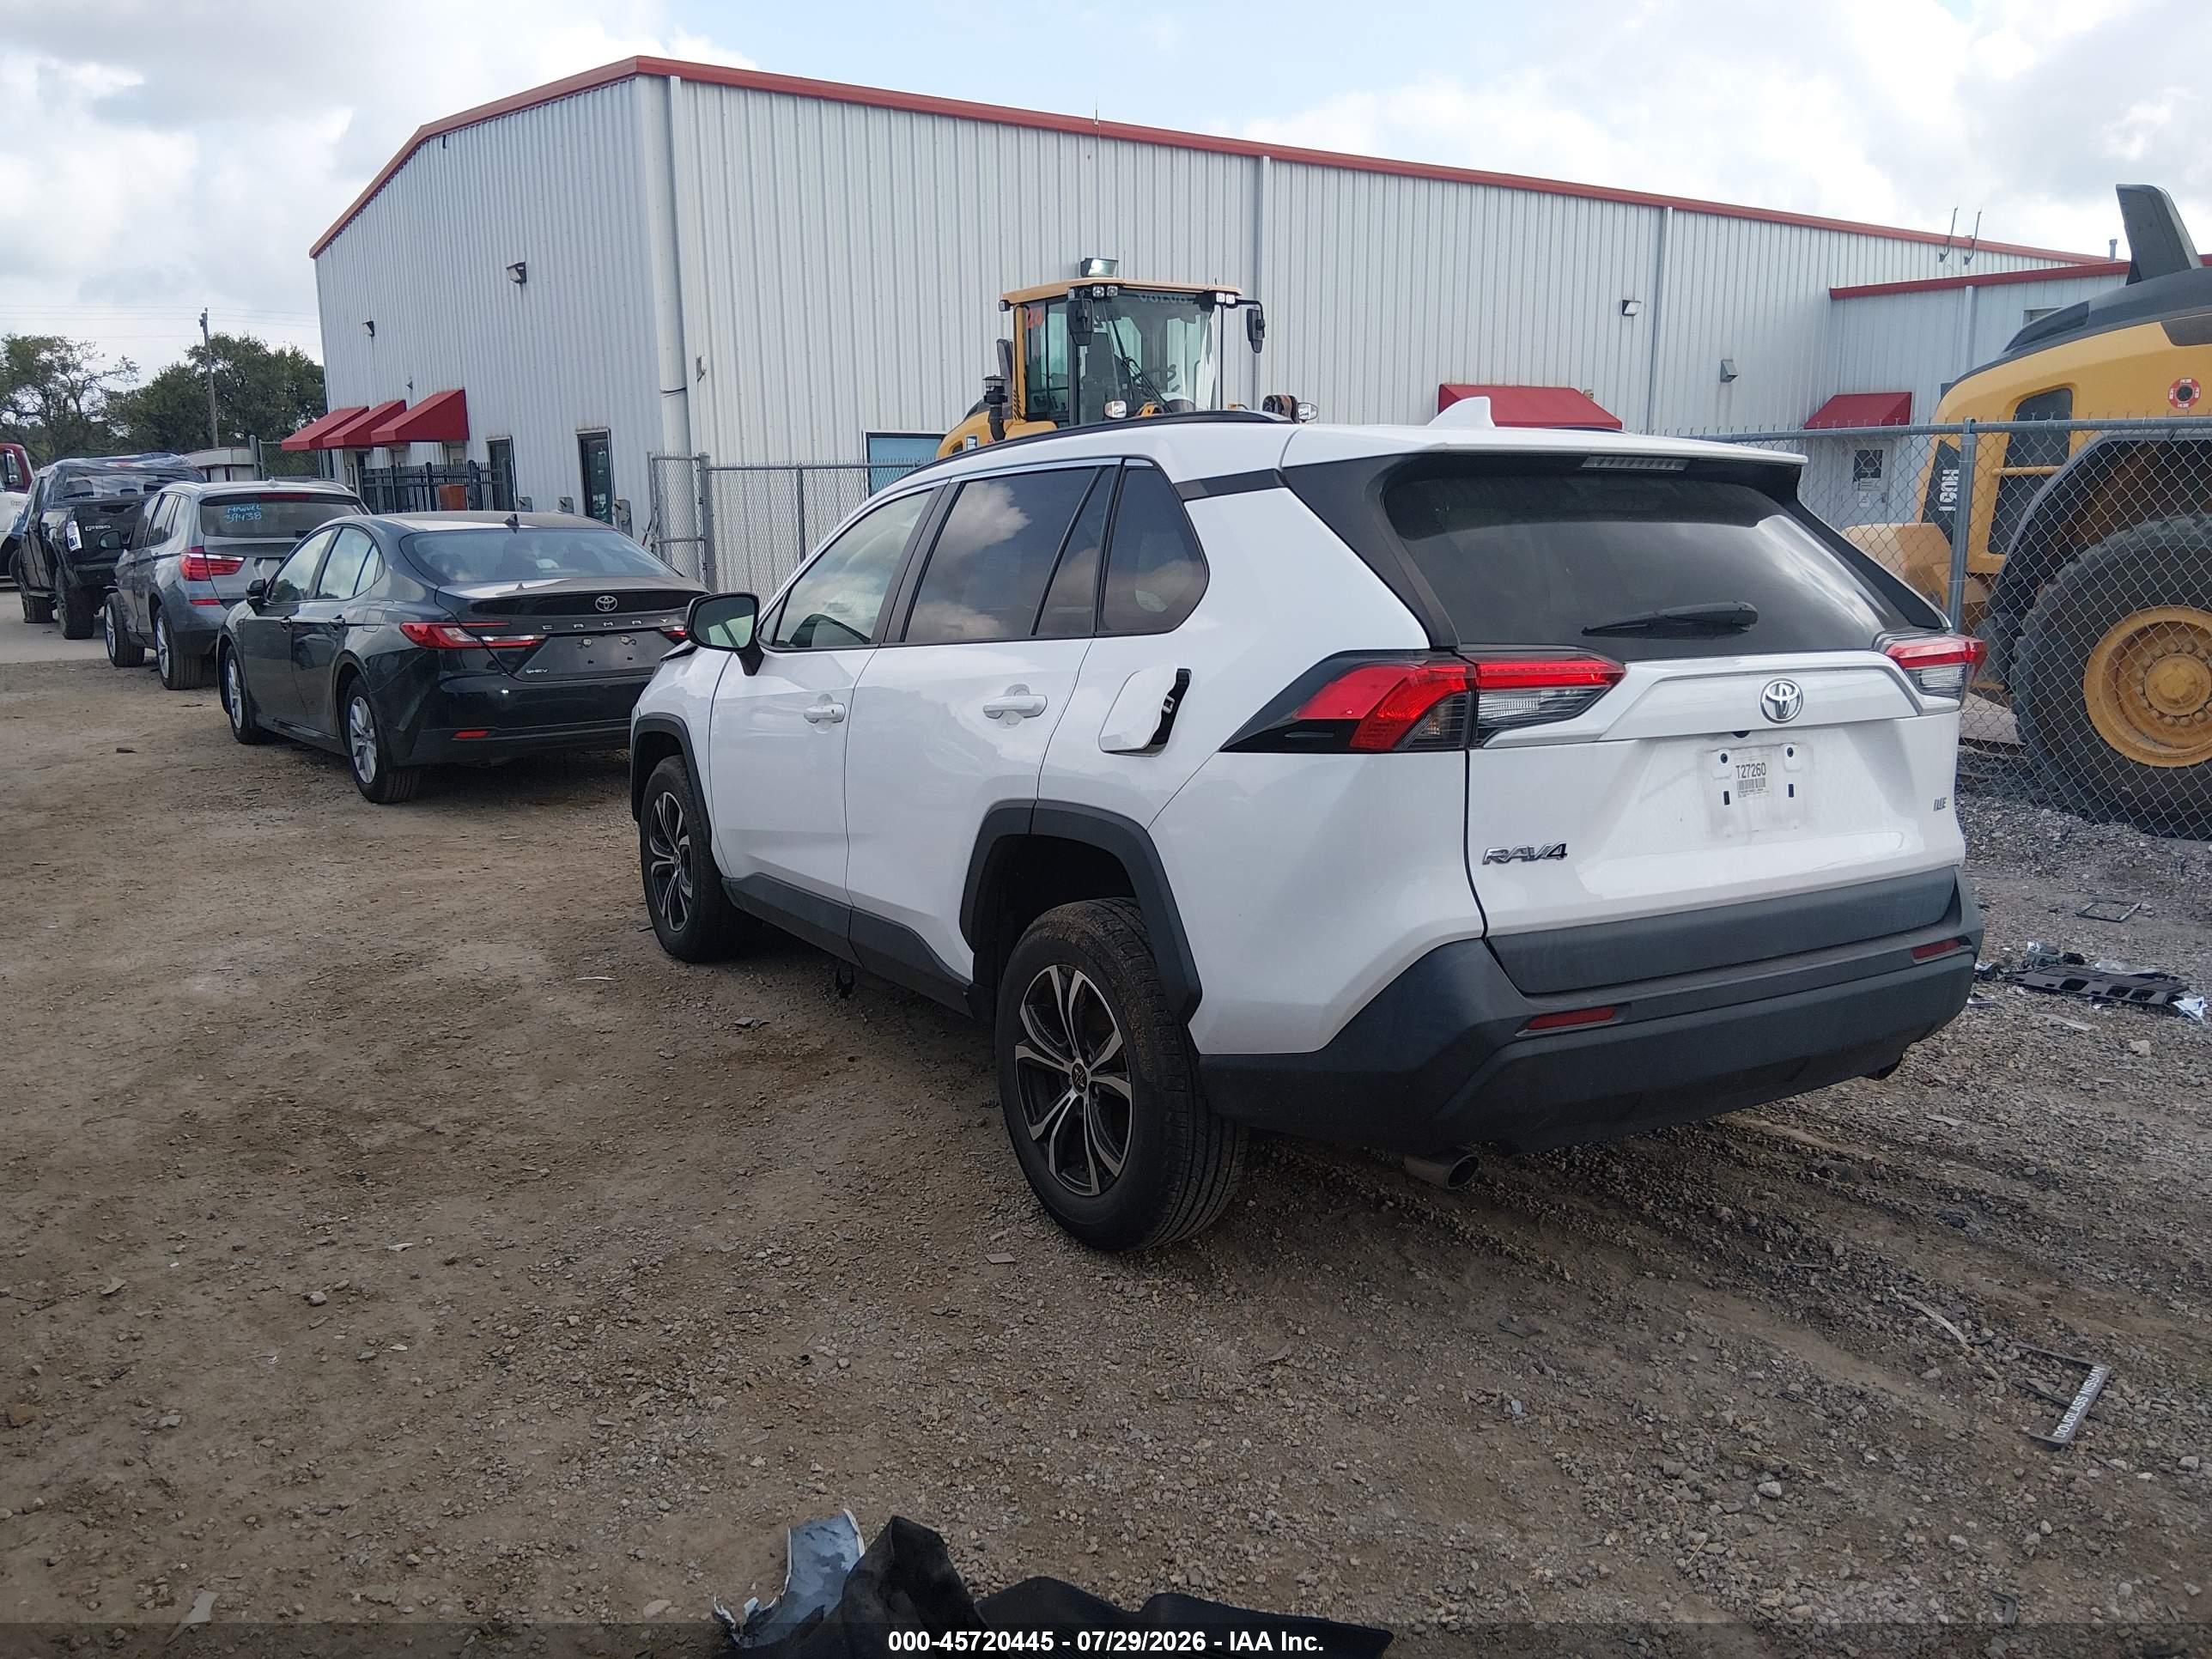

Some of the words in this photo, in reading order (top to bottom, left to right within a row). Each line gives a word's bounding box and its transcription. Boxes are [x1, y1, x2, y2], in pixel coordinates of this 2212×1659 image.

[542, 617, 669, 631] CAMRY
[1735, 763, 1766, 779] T27260
[1482, 842, 1568, 866] RAV4
[2052, 1395, 2089, 1438] DOUGLASS
[2079, 1366, 2106, 1395] NISSAN
